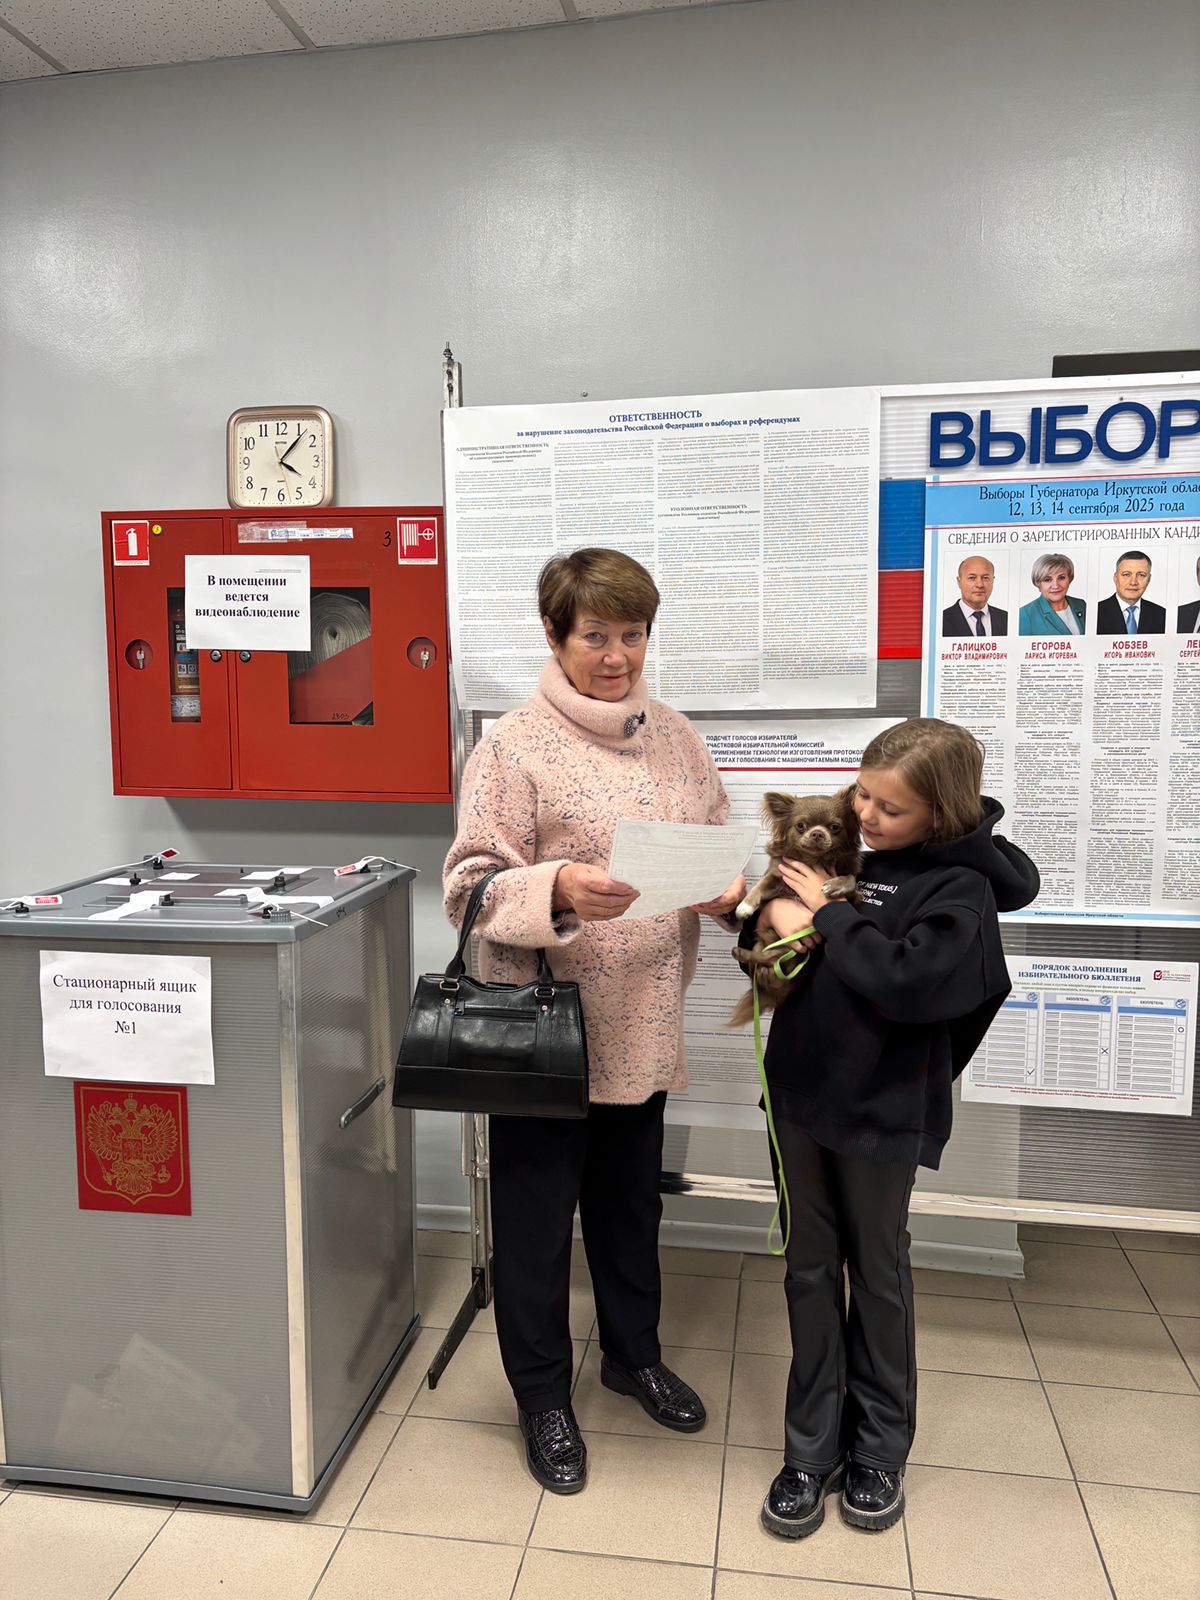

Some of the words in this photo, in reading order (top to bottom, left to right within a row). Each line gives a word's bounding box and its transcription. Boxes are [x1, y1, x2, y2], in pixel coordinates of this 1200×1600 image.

[609, 410, 702, 423] ОТВЕТСТВЕННОСТЬ
[259, 423, 268, 437] 11
[276, 421, 288, 436] 12
[525, 429, 562, 438] нарушение
[563, 426, 622, 436] законодательства
[624, 422, 664, 432] Российской
[665, 421, 704, 431] Федерации
[711, 418, 741, 428] выборах
[749, 416, 800, 427] референдумах
[244, 436, 255, 450] 10
[308, 434, 316, 448] 2
[243, 456, 250, 470] 9
[313, 454, 320, 468] 3
[246, 475, 254, 490] 8
[308, 475, 317, 489] 4
[260, 487, 268, 501] 7
[277, 488, 285, 502] 6
[295, 486, 303, 500] 5
[980, 486, 1025, 502] Выборы
[1030, 483, 1099, 501] Губернатора
[1104, 481, 1167, 498] Иркутской
[1009, 501, 1024, 517] 12,
[1030, 501, 1046, 516] 13,
[1052, 501, 1064, 515] 14
[1068, 501, 1119, 516] сентября
[1124, 498, 1154, 513] 2025
[1160, 502, 1185, 512] года
[382, 531, 392, 547] 3
[948, 531, 1007, 546] СВЕДЕНИЯ
[1010, 531, 1019, 542] О
[1022, 526, 1160, 542] ЗАРЕГИСТРИРОВАННЫХ
[207, 575, 216, 586] В
[219, 577, 287, 587] помещении
[225, 593, 269, 602] ведется
[195, 607, 301, 618] видеонаблюдение
[952, 642, 997, 652] ГАЛИЦКОВ
[1031, 641, 1072, 651] ЕГОРОВА
[1112, 640, 1148, 650] КОБЗЕВ
[964, 652, 1008, 660] ВЛАДИМИРОВИЧ
[1025, 652, 1046, 660] ЛАРИСА
[1048, 651, 1077, 659] ИГОРЕВНА
[1104, 651, 1122, 659] ИГОРЬ
[1124, 650, 1156, 659] ИВАНОВИЧ
[864, 882, 878, 890] NEW
[1032, 963, 1070, 972] ПОРЯДОК
[1071, 965, 1128, 974] ЗАПОЛНЕНИЯ
[53, 974, 156, 993] Стационарный
[159, 981, 197, 993] ящик
[1018, 971, 1090, 981] ИЗБИРАТЕЛЬНОГО
[1091, 974, 1141, 983] БЮЛЛЕТЕНЯ
[69, 998, 93, 1010] для
[96, 1000, 182, 1014] голосования
[114, 1020, 136, 1034] №1
